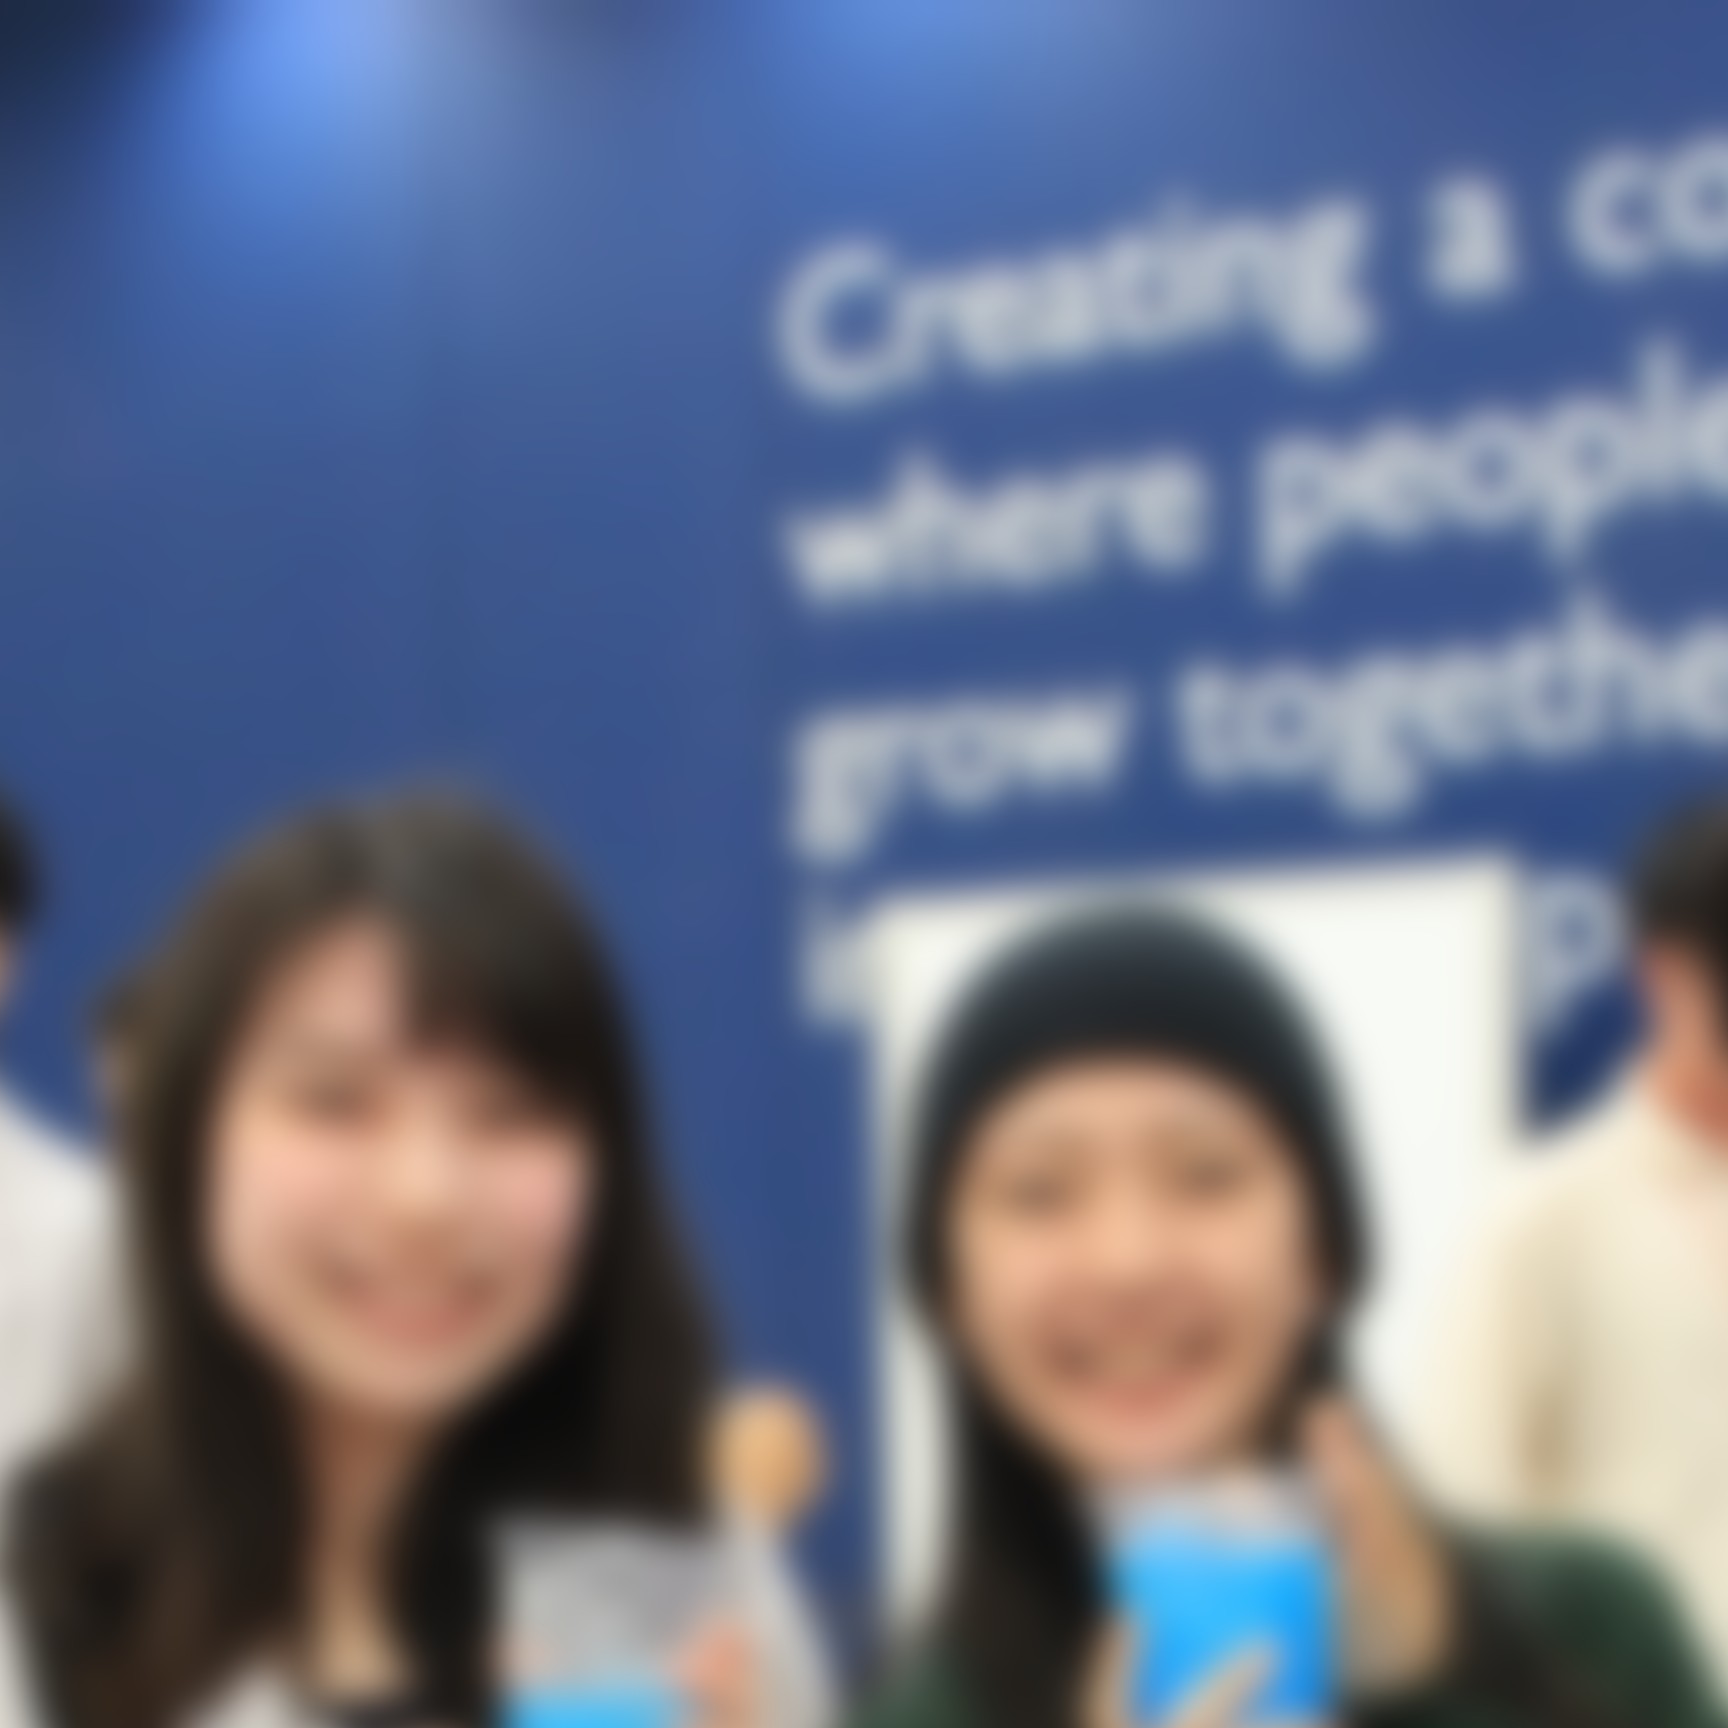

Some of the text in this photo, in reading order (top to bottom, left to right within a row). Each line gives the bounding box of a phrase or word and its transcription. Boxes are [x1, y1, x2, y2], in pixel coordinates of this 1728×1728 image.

[775, 200, 1370, 394] Creating
[1434, 178, 1510, 303] a
[790, 448, 1200, 596] where
[794, 692, 1130, 862] grow
